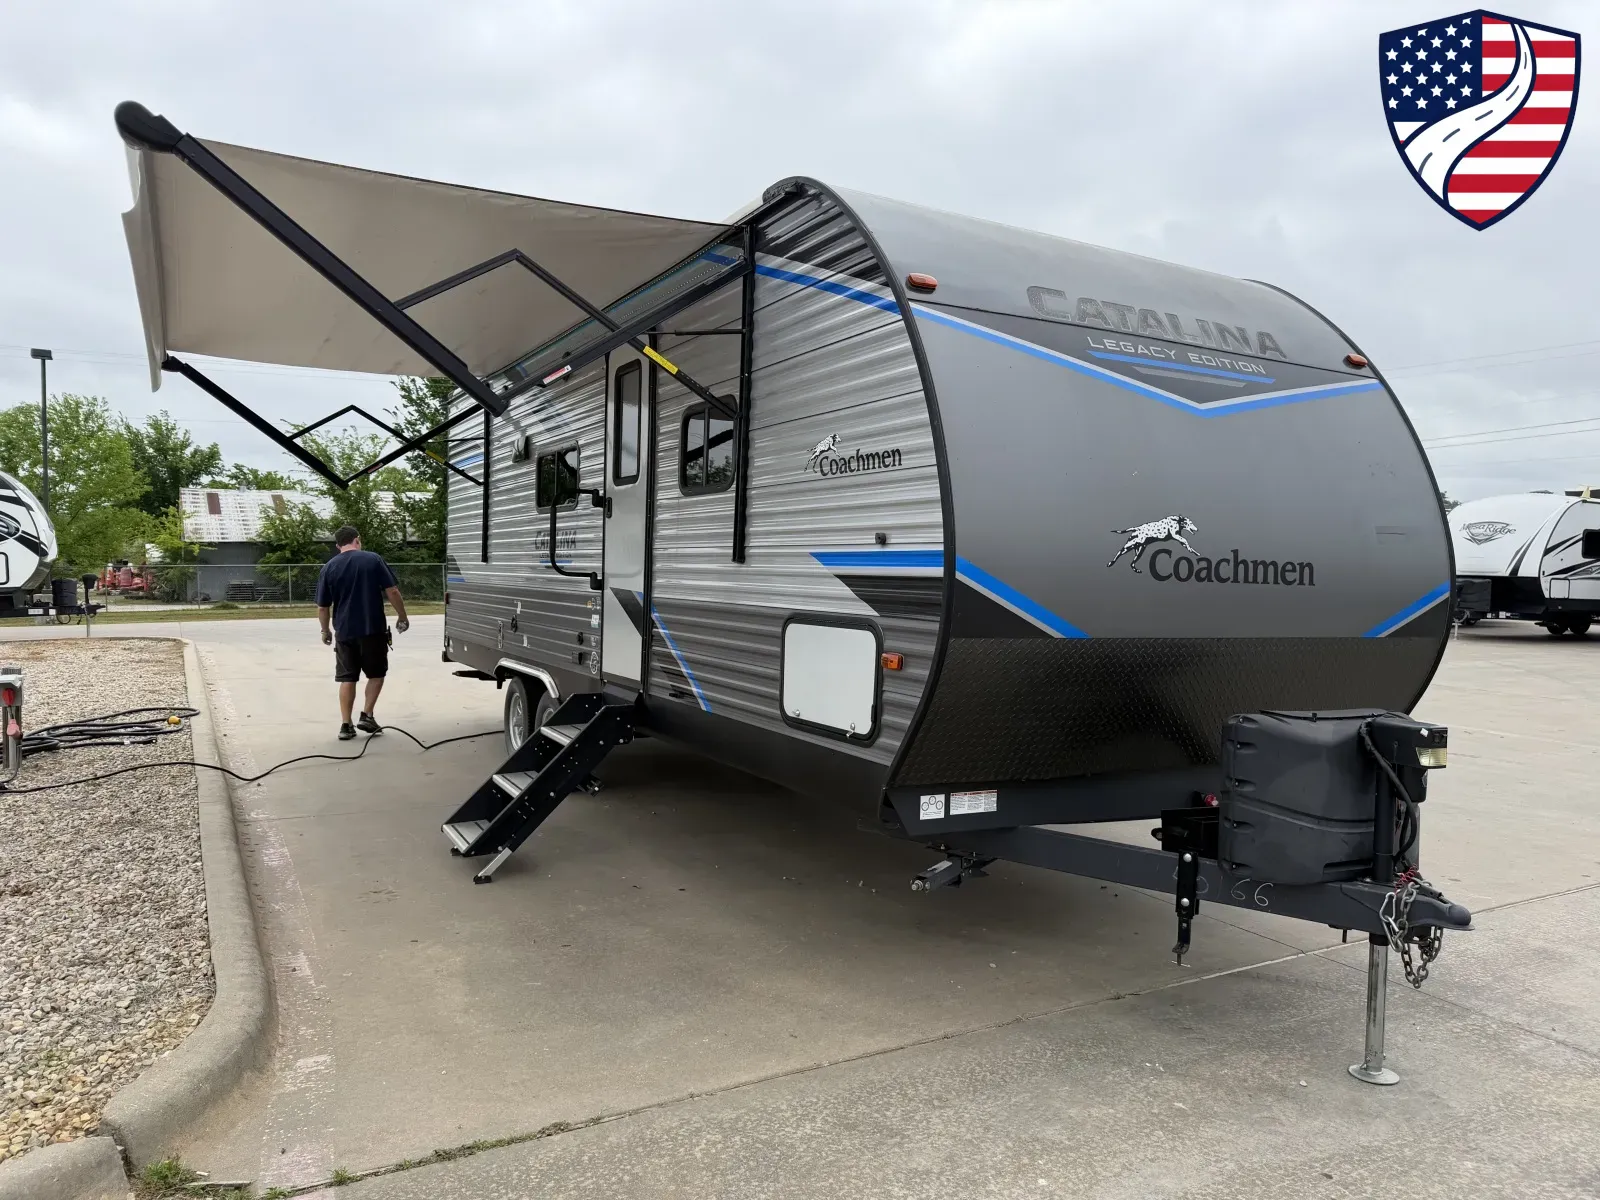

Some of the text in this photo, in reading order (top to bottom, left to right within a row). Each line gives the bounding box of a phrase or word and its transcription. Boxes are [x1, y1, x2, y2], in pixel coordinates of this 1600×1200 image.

[1026, 285, 1288, 360] CATALINA
[1087, 336, 1266, 375] LEGACY EDITION
[820, 447, 903, 477] Coachmen
[1149, 549, 1316, 586] Coachmen
